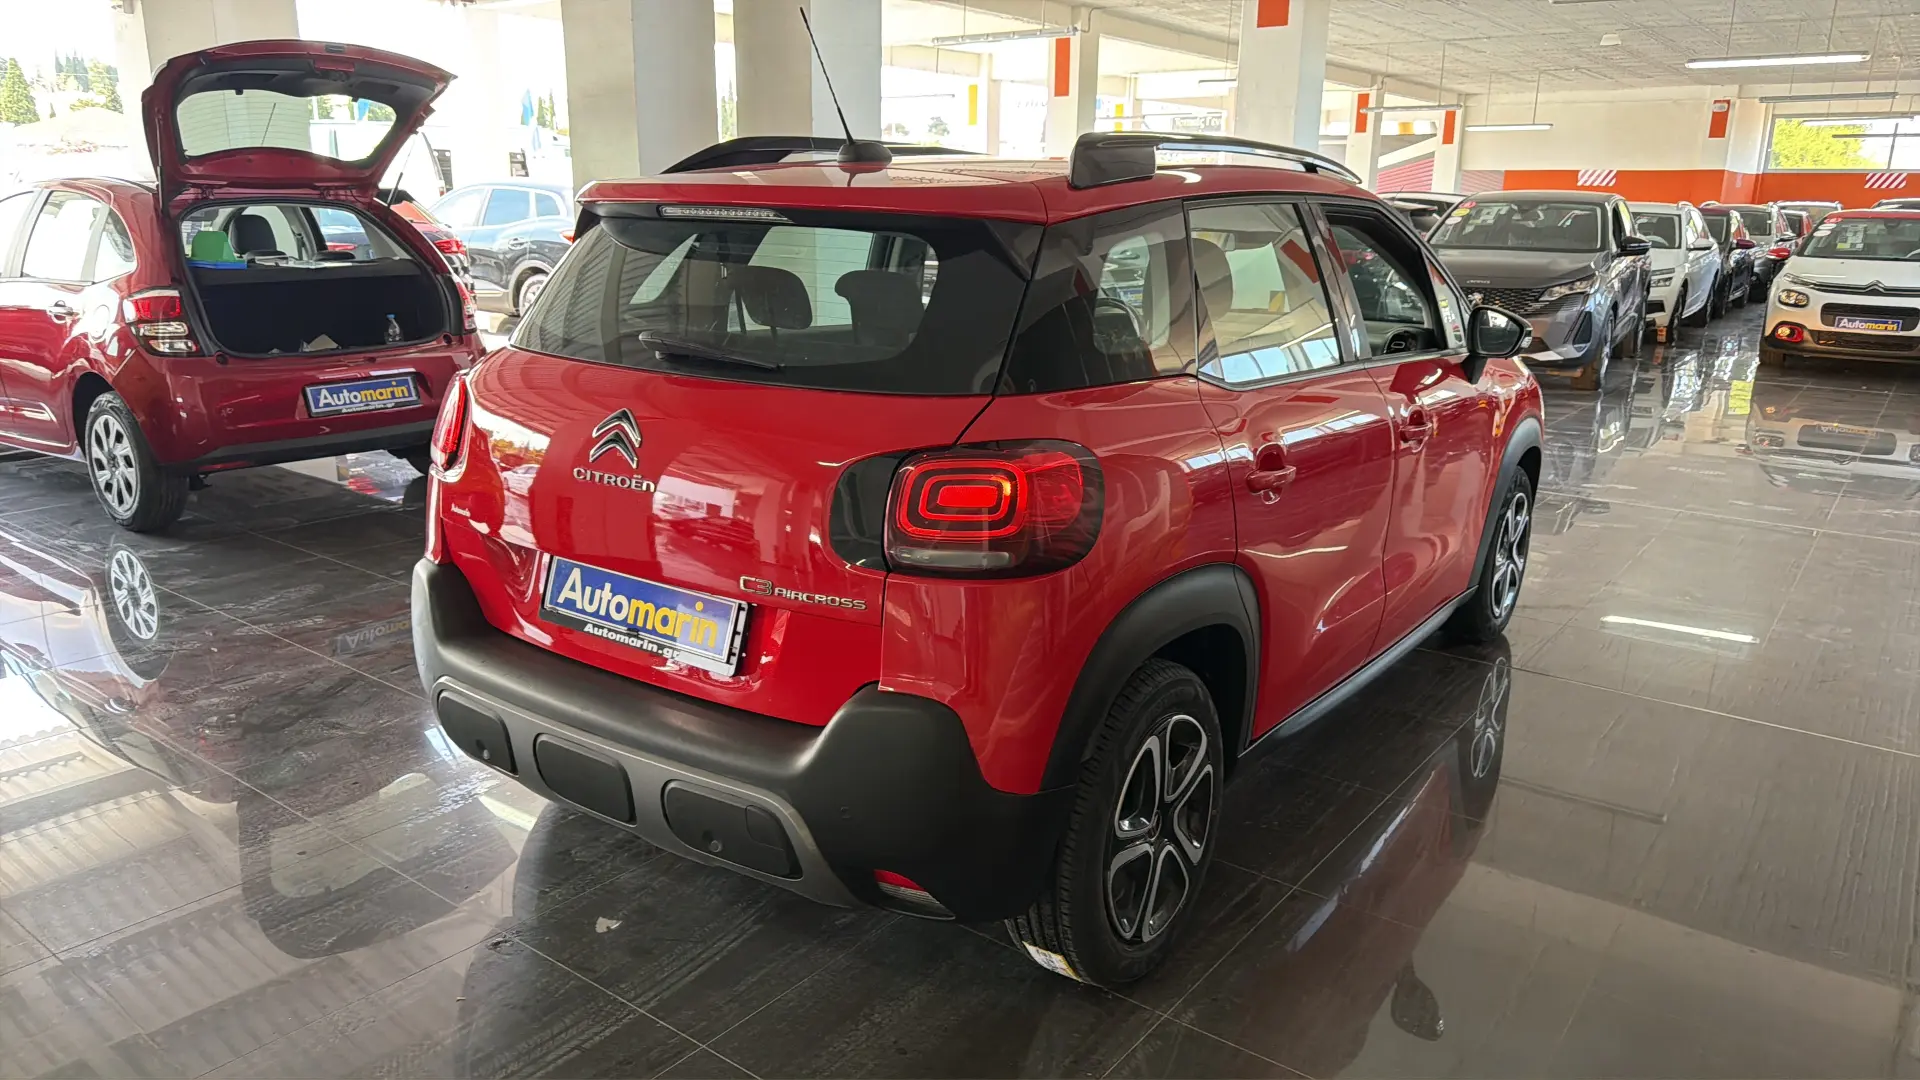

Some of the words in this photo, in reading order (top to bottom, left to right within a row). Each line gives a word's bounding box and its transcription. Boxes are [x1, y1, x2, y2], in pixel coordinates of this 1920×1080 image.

[1838, 318, 1897, 331] Automarin
[318, 381, 409, 408] Automarin
[341, 402, 395, 414] Automarin.gr
[557, 567, 718, 648] Automarin
[739, 575, 773, 596] C3
[774, 587, 868, 610] AIRCROSS
[583, 623, 681, 660] Automarin.gr
